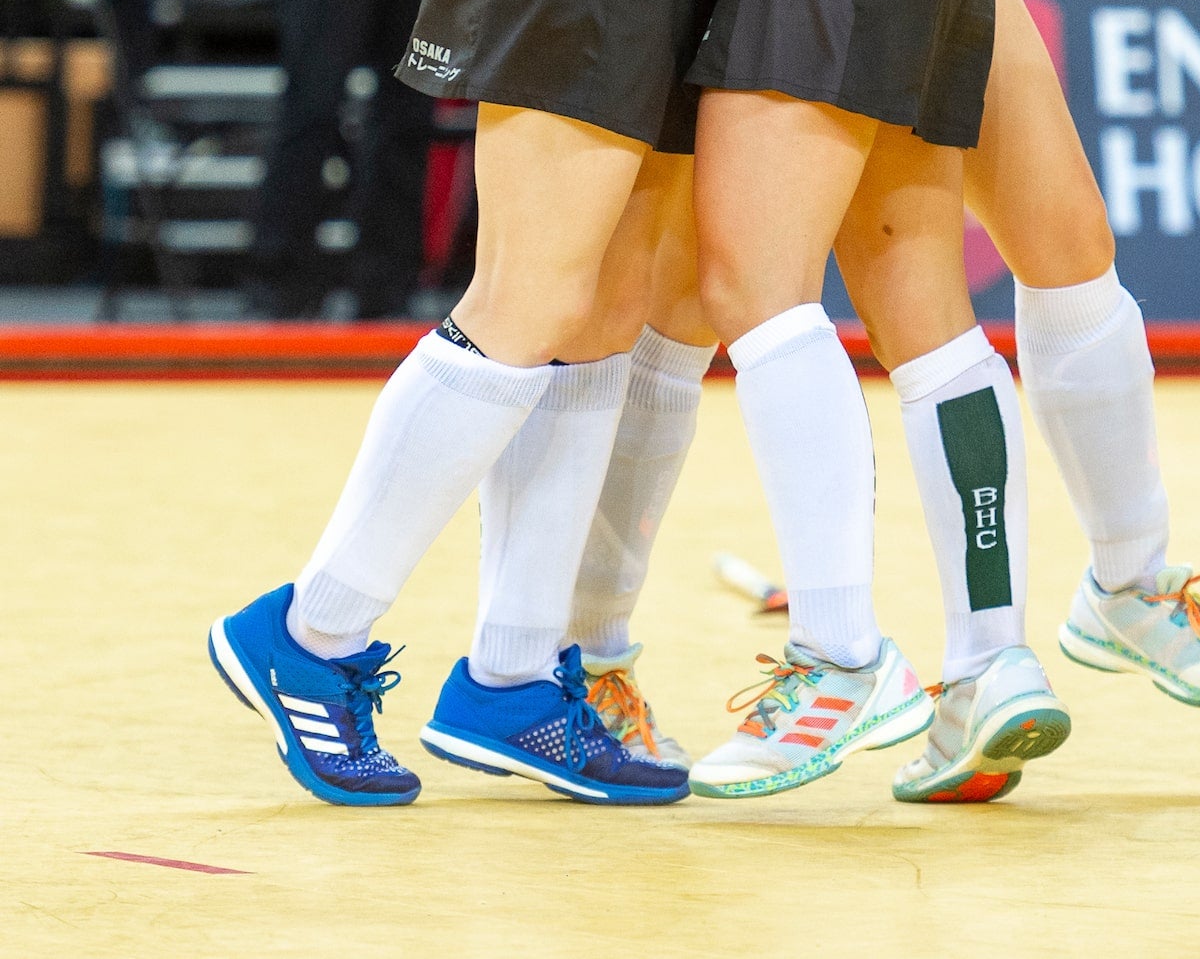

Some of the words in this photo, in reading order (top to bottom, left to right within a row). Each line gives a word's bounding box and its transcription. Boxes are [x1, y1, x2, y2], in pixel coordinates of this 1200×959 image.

[412, 37, 451, 64] OSAKA
[407, 52, 461, 82] トレーニング
[971, 486, 998, 550] BHC
